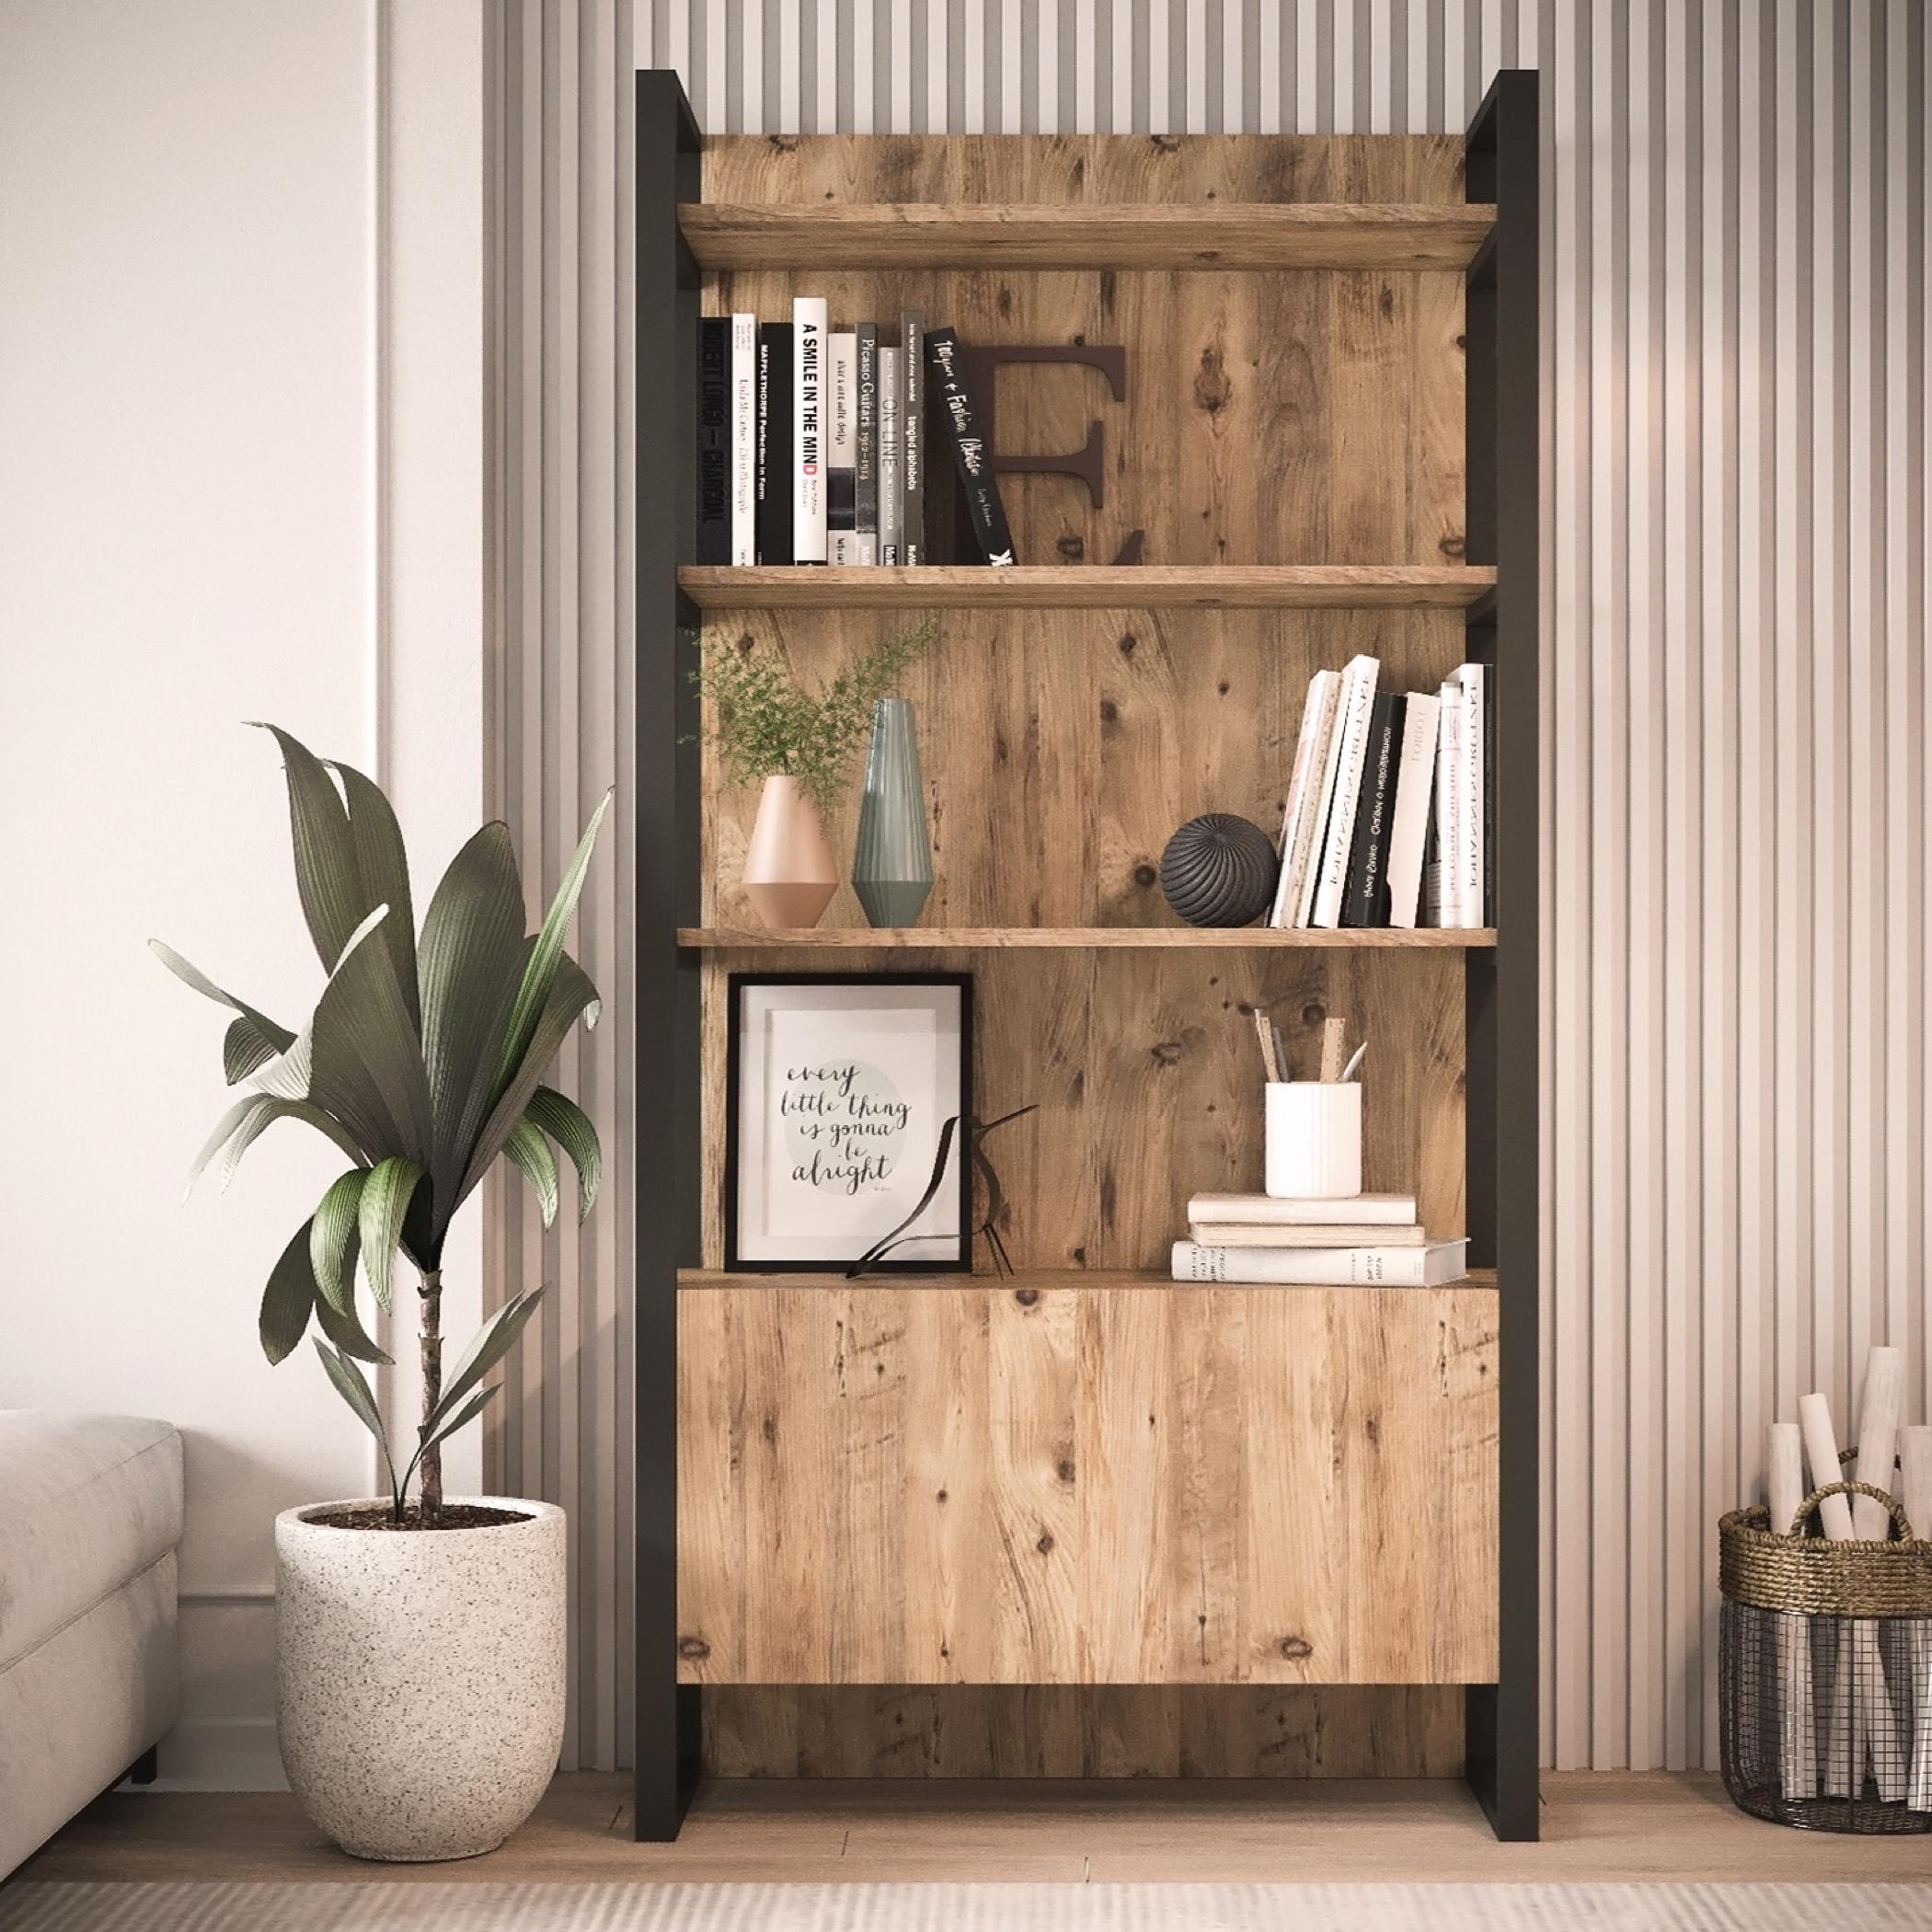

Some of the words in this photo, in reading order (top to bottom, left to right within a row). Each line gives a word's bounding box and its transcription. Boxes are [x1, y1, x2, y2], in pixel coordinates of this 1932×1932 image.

[802, 324, 818, 334] A
[802, 339, 818, 382] SMILE
[861, 339, 874, 380] Picasso
[760, 344, 769, 418] MAPPLETHORPE
[802, 386, 818, 401] IN
[802, 406, 818, 432] THE
[861, 383, 874, 426] Guitars
[882, 400, 899, 422] ON
[947, 395, 972, 433] Fashion
[802, 437, 818, 476] MIND
[882, 431, 899, 467] LINE
[702, 450, 726, 523] CHARCOAL
[787, 1065, 861, 1098] every
[781, 1089, 840, 1117] little
[846, 1093, 913, 1130] thing
[799, 1115, 825, 1140] is
[830, 1122, 896, 1148] gonna
[845, 1137, 868, 1161] be
[792, 1149, 892, 1196] alright
